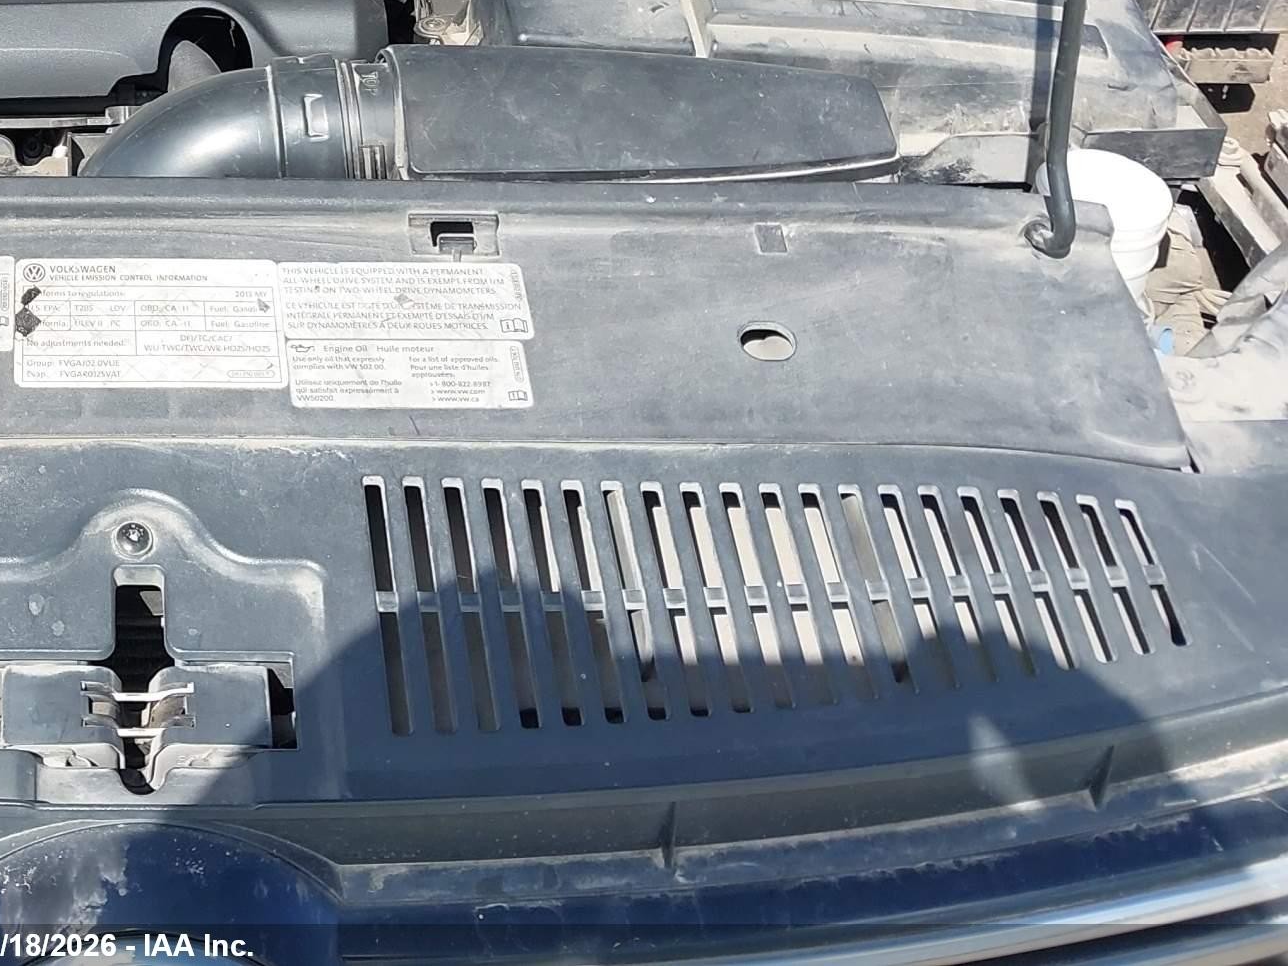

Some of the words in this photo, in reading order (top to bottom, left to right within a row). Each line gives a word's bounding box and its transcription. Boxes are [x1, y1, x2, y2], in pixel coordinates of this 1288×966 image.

[49, 265, 116, 274] VOLKSWAGEN
[156, 274, 208, 282] INFORMATION
[323, 345, 353, 354] Engine
[355, 344, 368, 353] Oil
[376, 345, 400, 353] Huile
[401, 345, 434, 353] moteur
